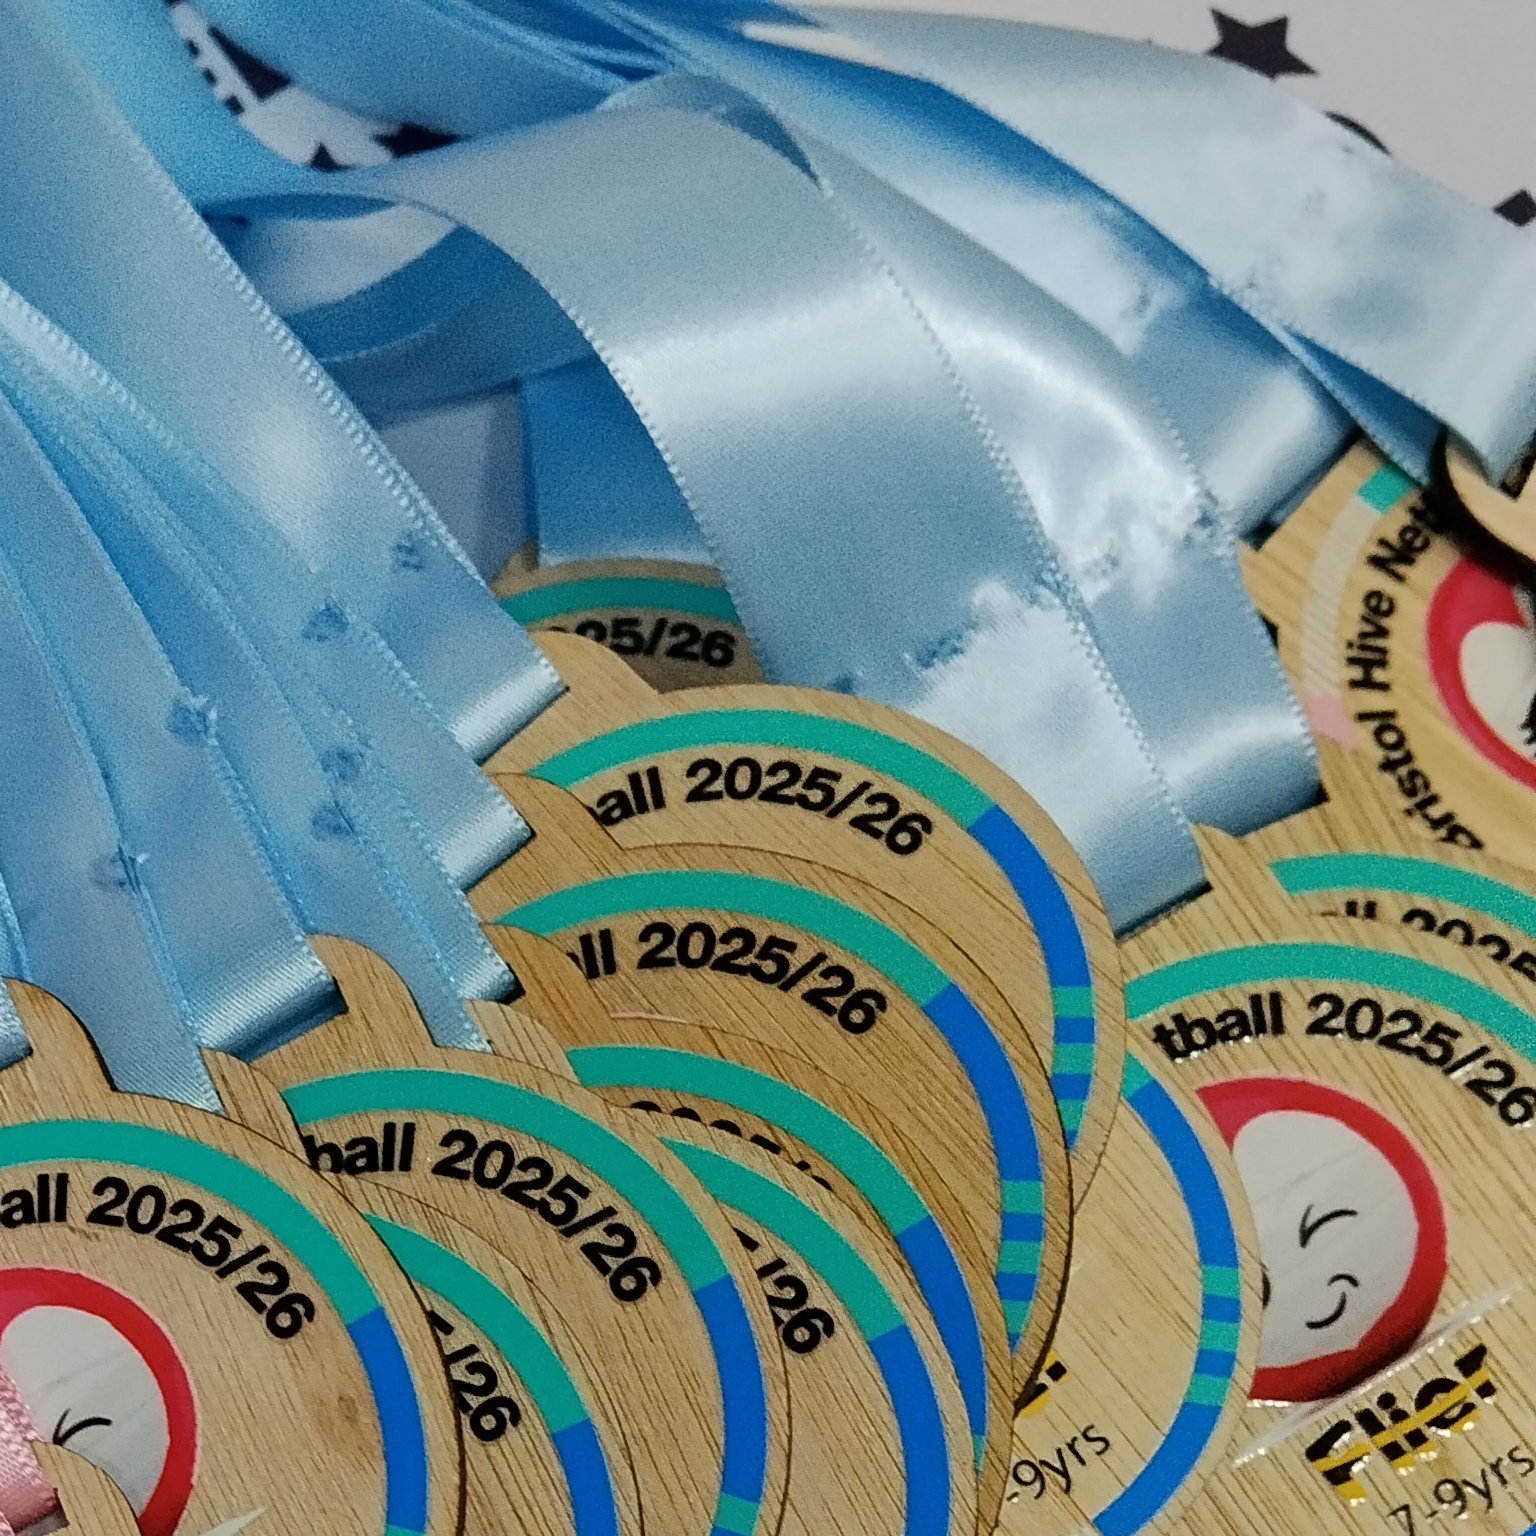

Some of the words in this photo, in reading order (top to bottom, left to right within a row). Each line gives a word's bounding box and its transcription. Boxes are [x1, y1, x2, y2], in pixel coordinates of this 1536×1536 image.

[549, 617, 736, 668] 5/26
[1345, 589, 1395, 692] Hive
[587, 766, 667, 828] all
[685, 757, 933, 856] 2025/26
[567, 928, 617, 980] ll
[636, 921, 888, 1035] 2025/26
[1153, 991, 1286, 1062] tball
[1305, 992, 1536, 1128] 2025/26
[87, 1176, 316, 1339] 2025/26
[432, 1128, 662, 1301] 2025/26
[732, 1227, 835, 1354] /26
[426, 1310, 522, 1442] /26
[1305, 1343, 1498, 1505] Flier
[1006, 1423, 1111, 1502] -9yrs
